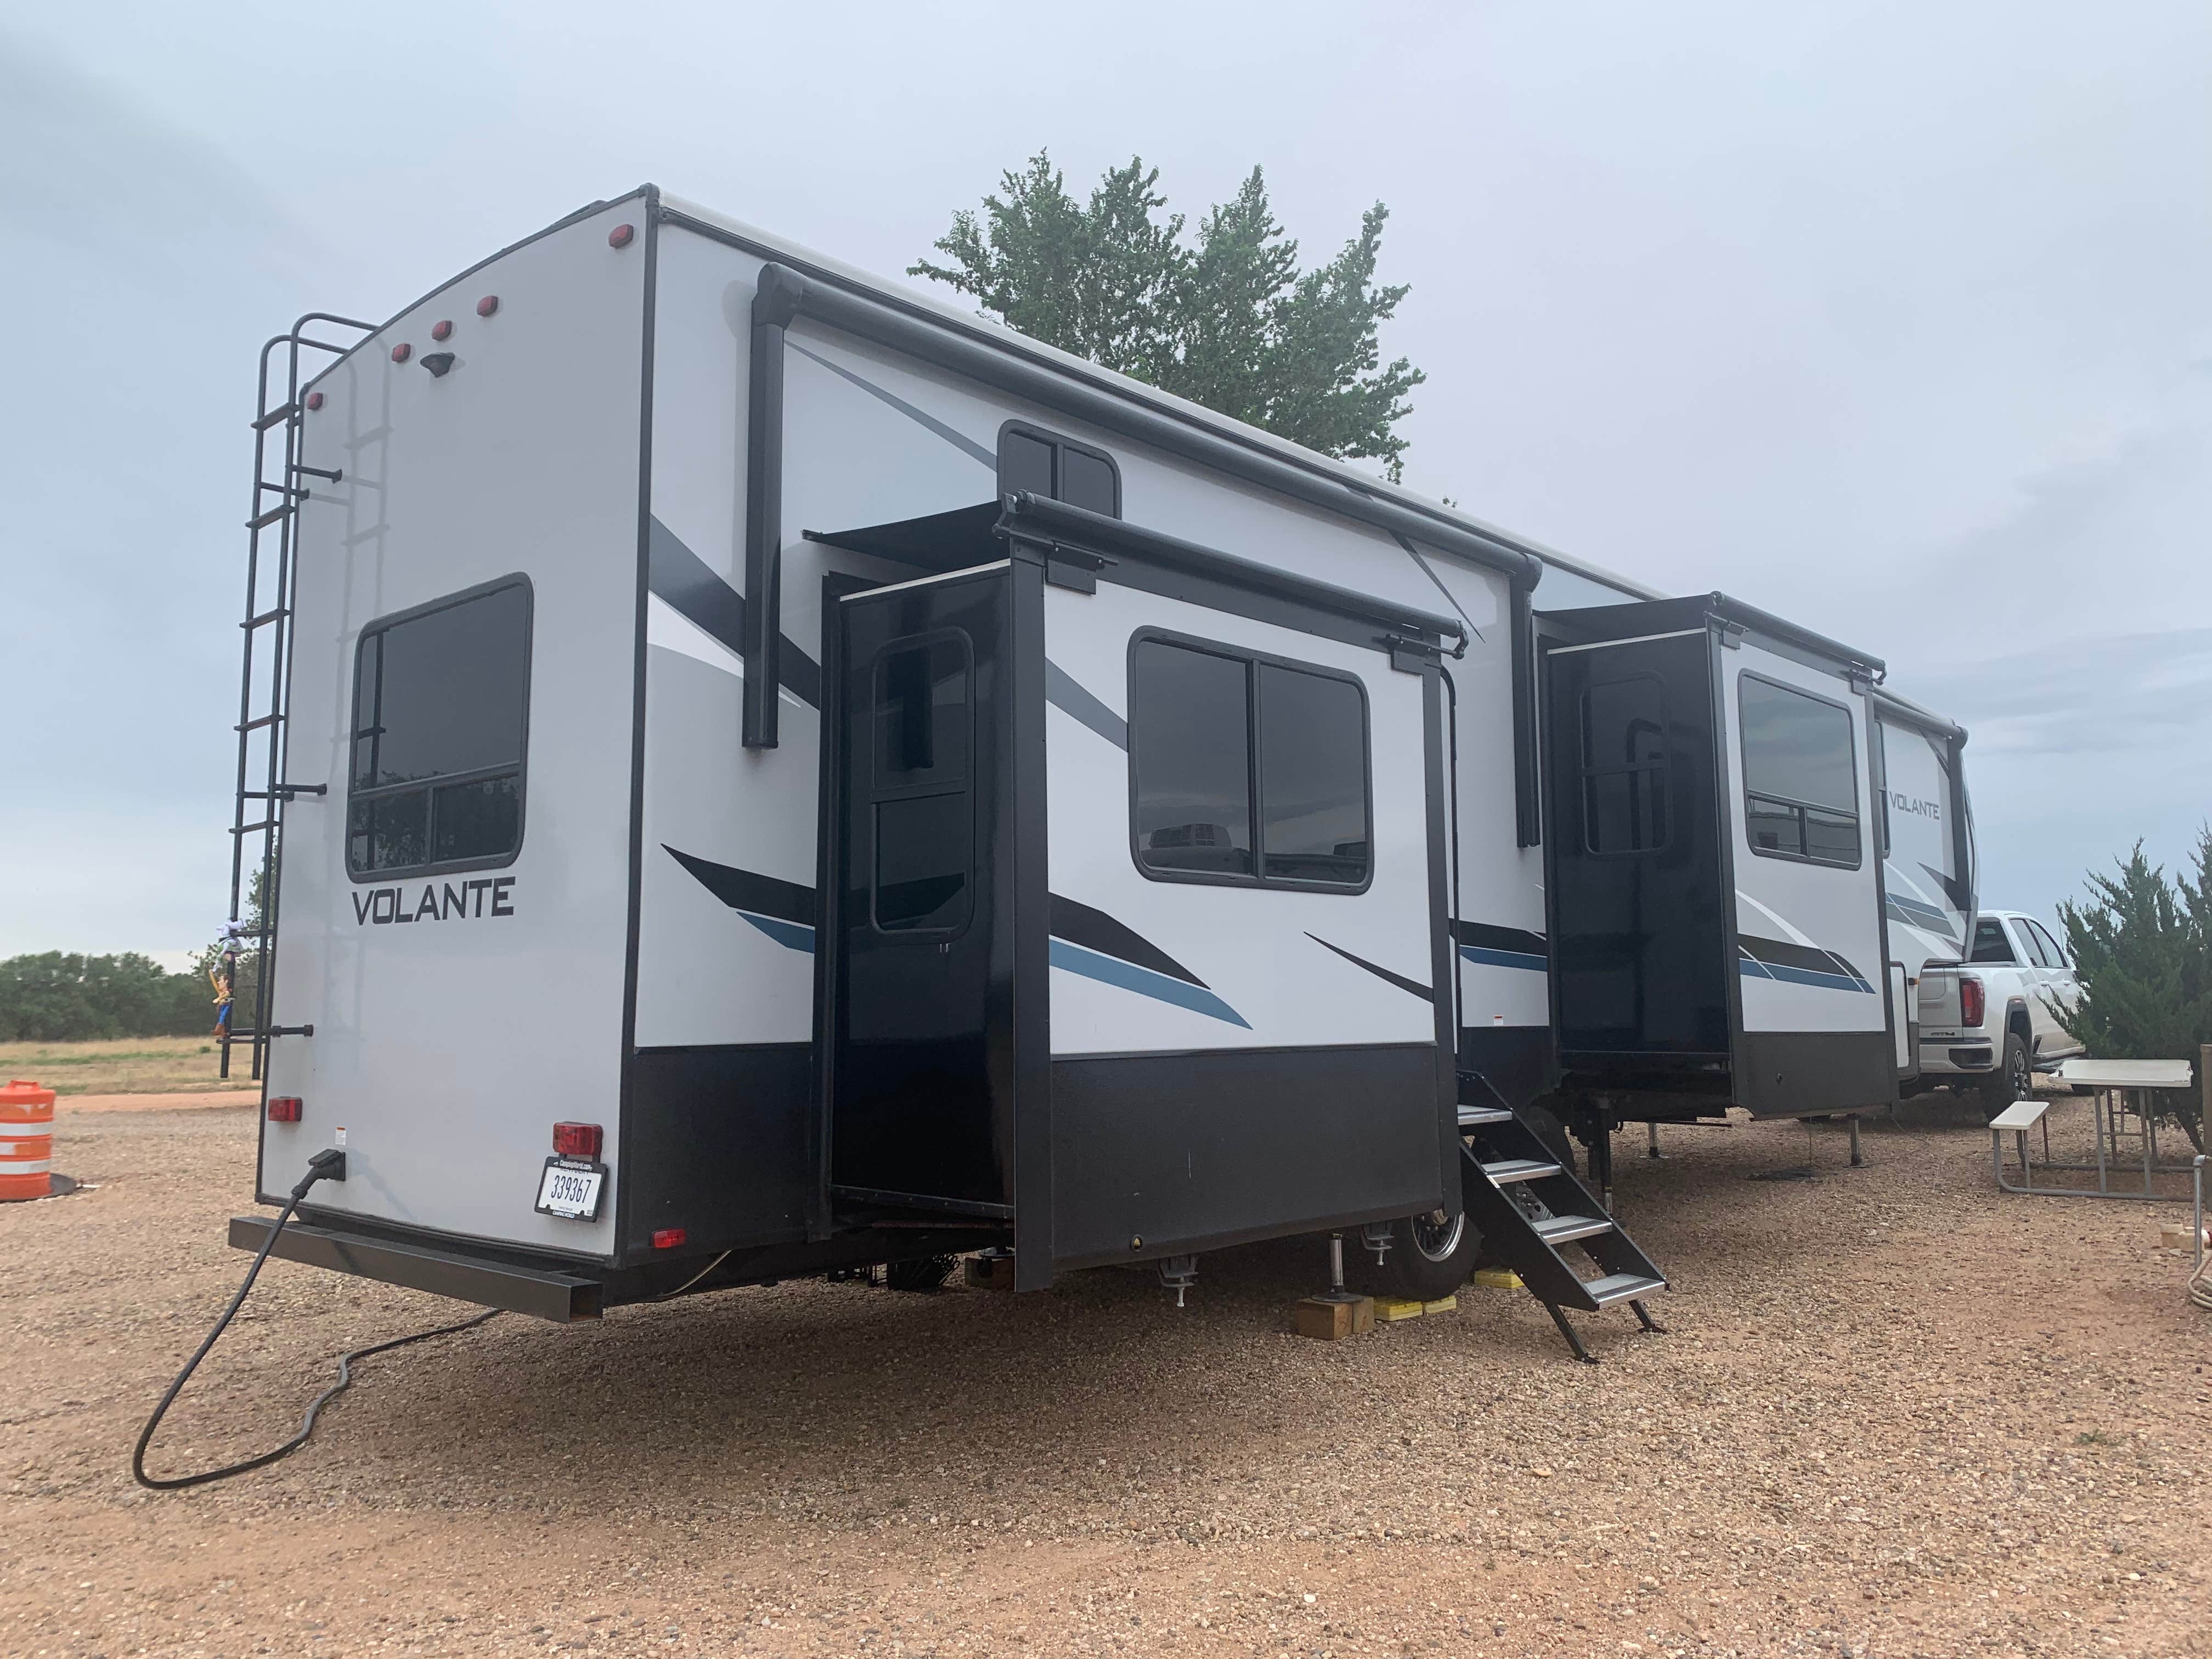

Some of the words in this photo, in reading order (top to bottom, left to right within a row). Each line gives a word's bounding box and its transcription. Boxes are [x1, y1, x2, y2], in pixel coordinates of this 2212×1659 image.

[1889, 791, 1940, 820] VOLANTE
[352, 876, 516, 926] VOLANTE
[551, 1175, 591, 1203] 339367
